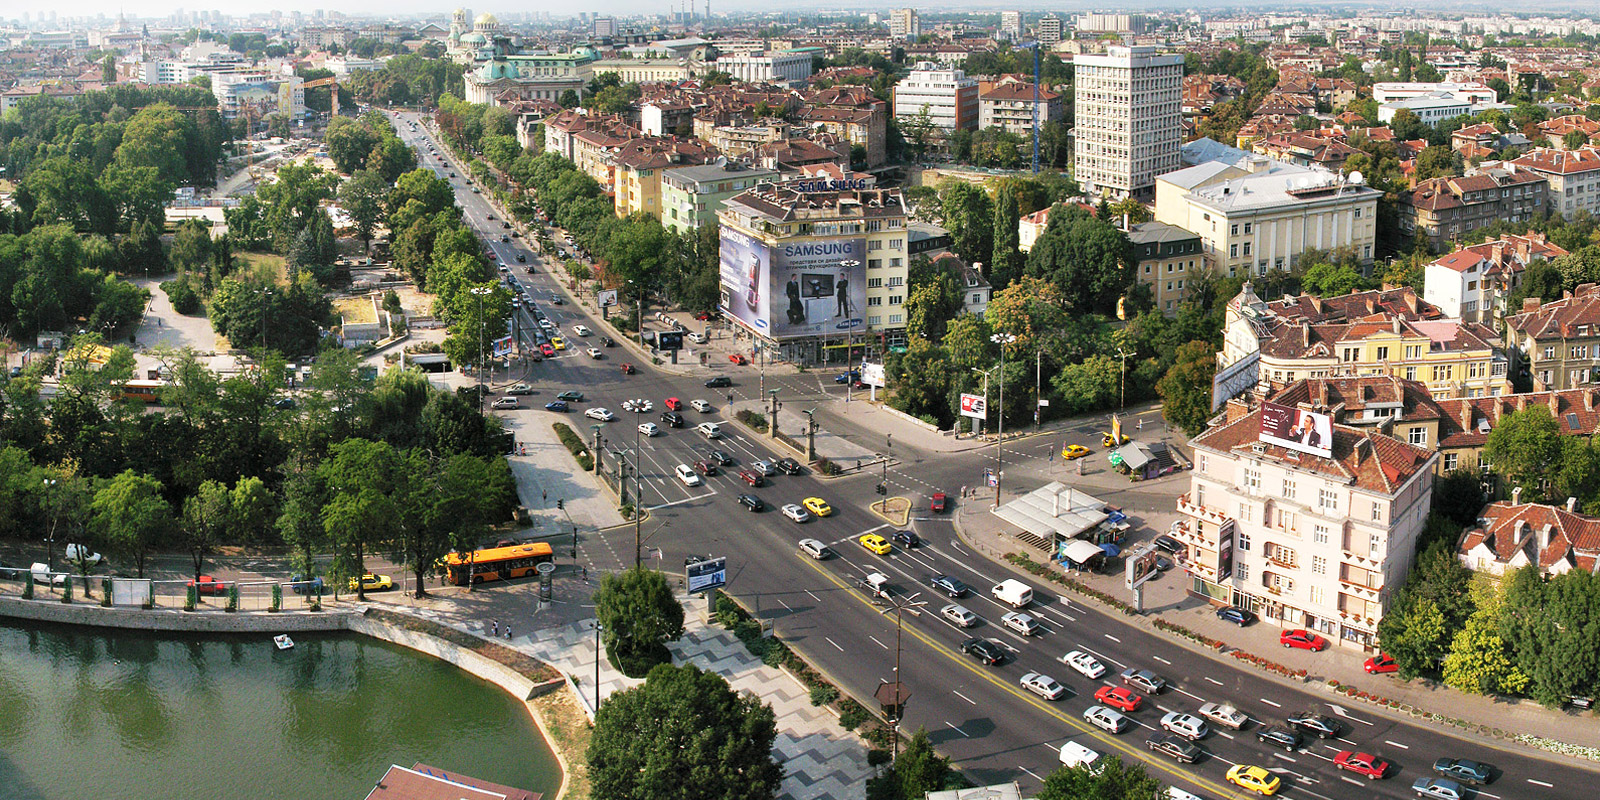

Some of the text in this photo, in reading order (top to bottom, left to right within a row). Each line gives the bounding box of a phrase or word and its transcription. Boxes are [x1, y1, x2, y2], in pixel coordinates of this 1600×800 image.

[798, 178, 866, 192] SAMSUNG
[720, 226, 750, 248] SAMSUNG
[785, 243, 852, 257] SAMSUNG
